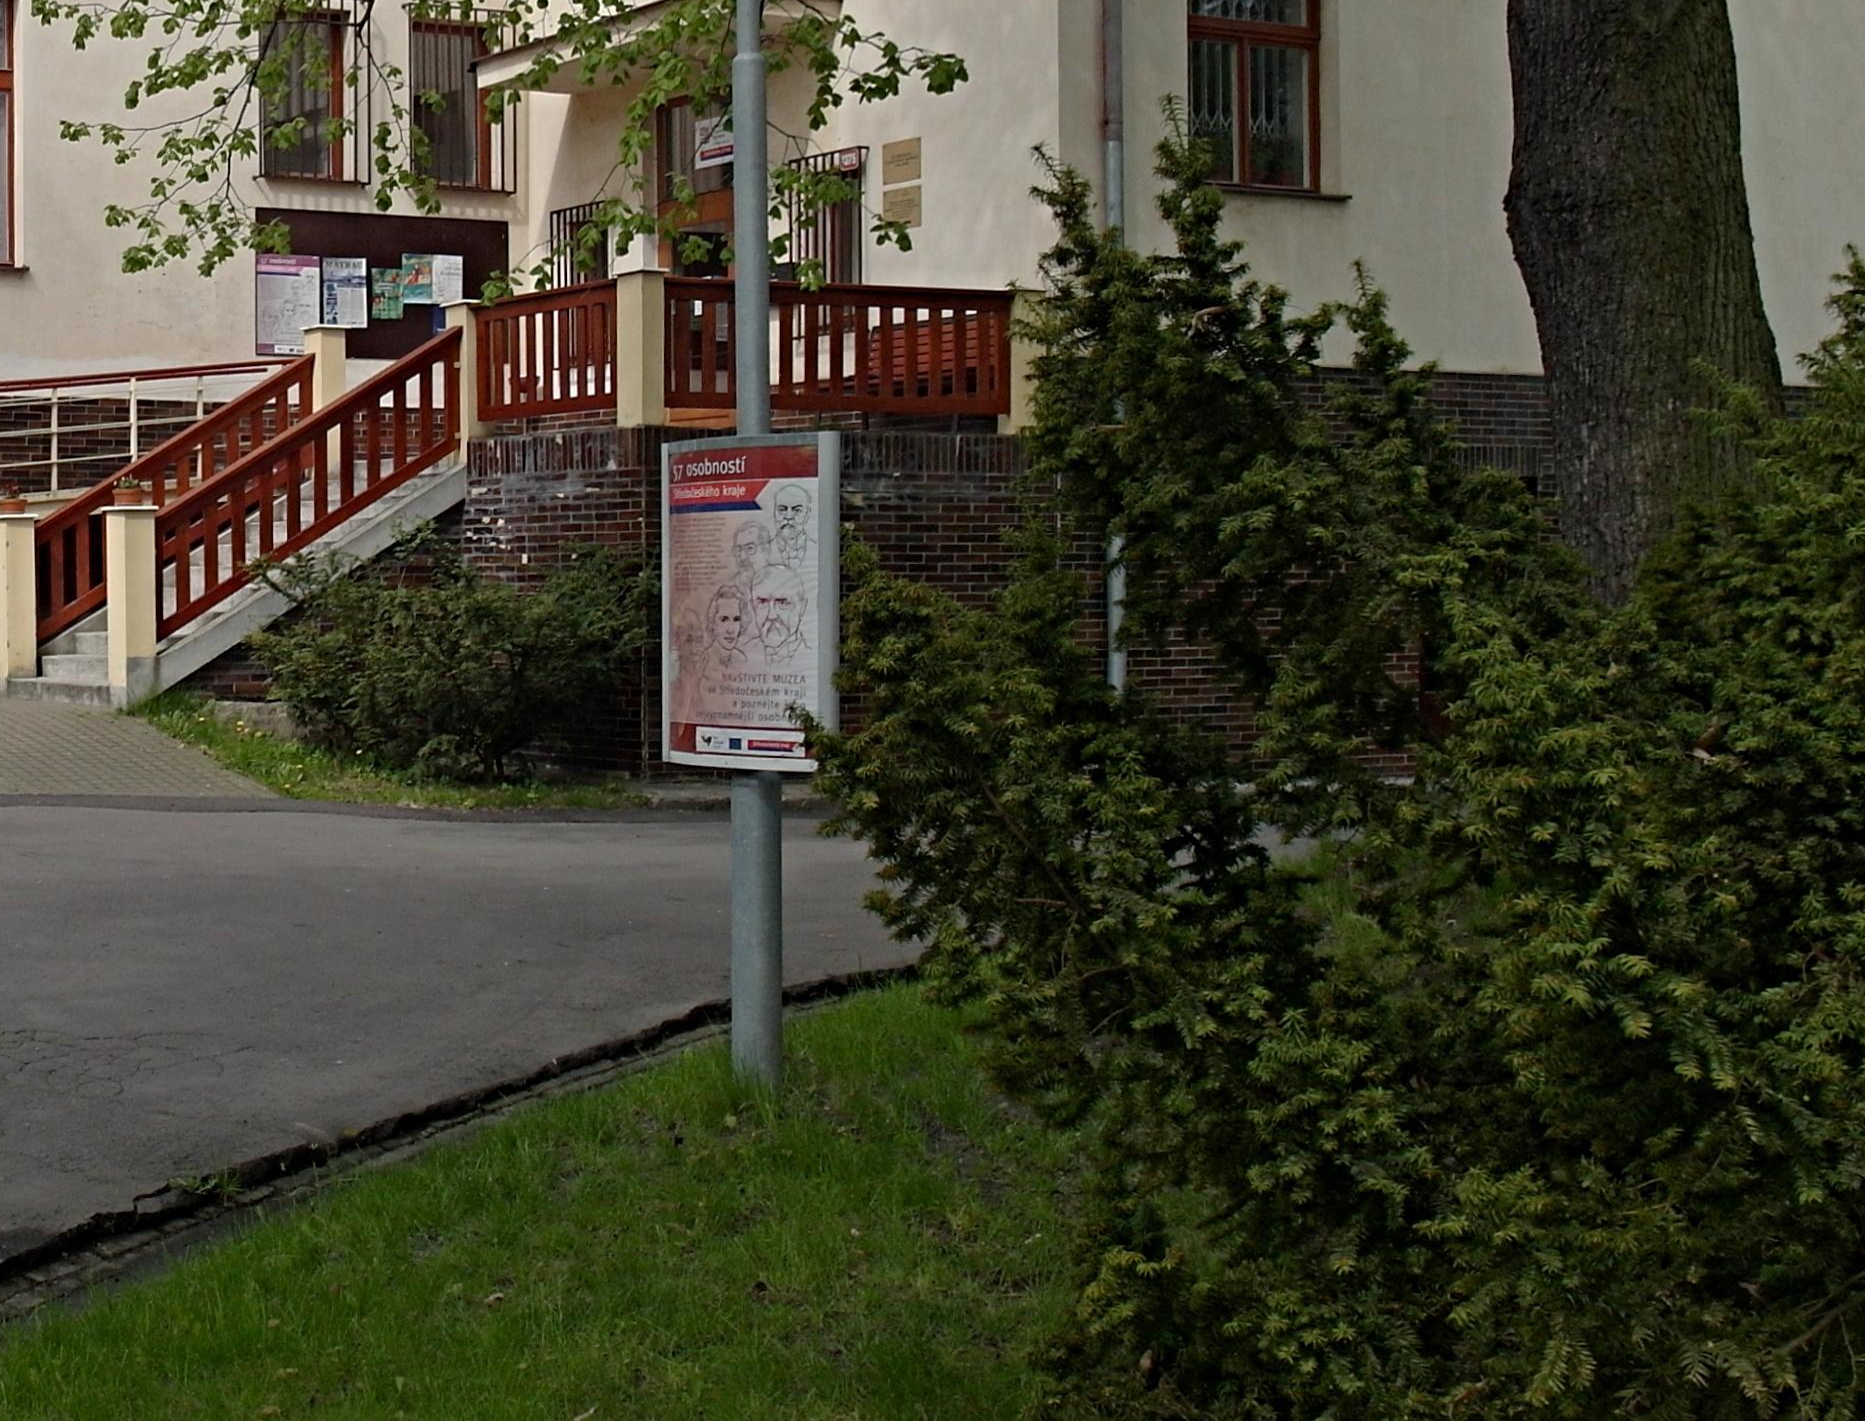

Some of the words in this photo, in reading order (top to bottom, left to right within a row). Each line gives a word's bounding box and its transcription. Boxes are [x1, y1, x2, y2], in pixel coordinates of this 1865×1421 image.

[673, 465, 683, 482] 57
[686, 456, 747, 476] osobností
[722, 484, 746, 498] kraje
[773, 674, 807, 685] MUZEA
[784, 688, 807, 699] kraji
[741, 700, 780, 710] poznejte
